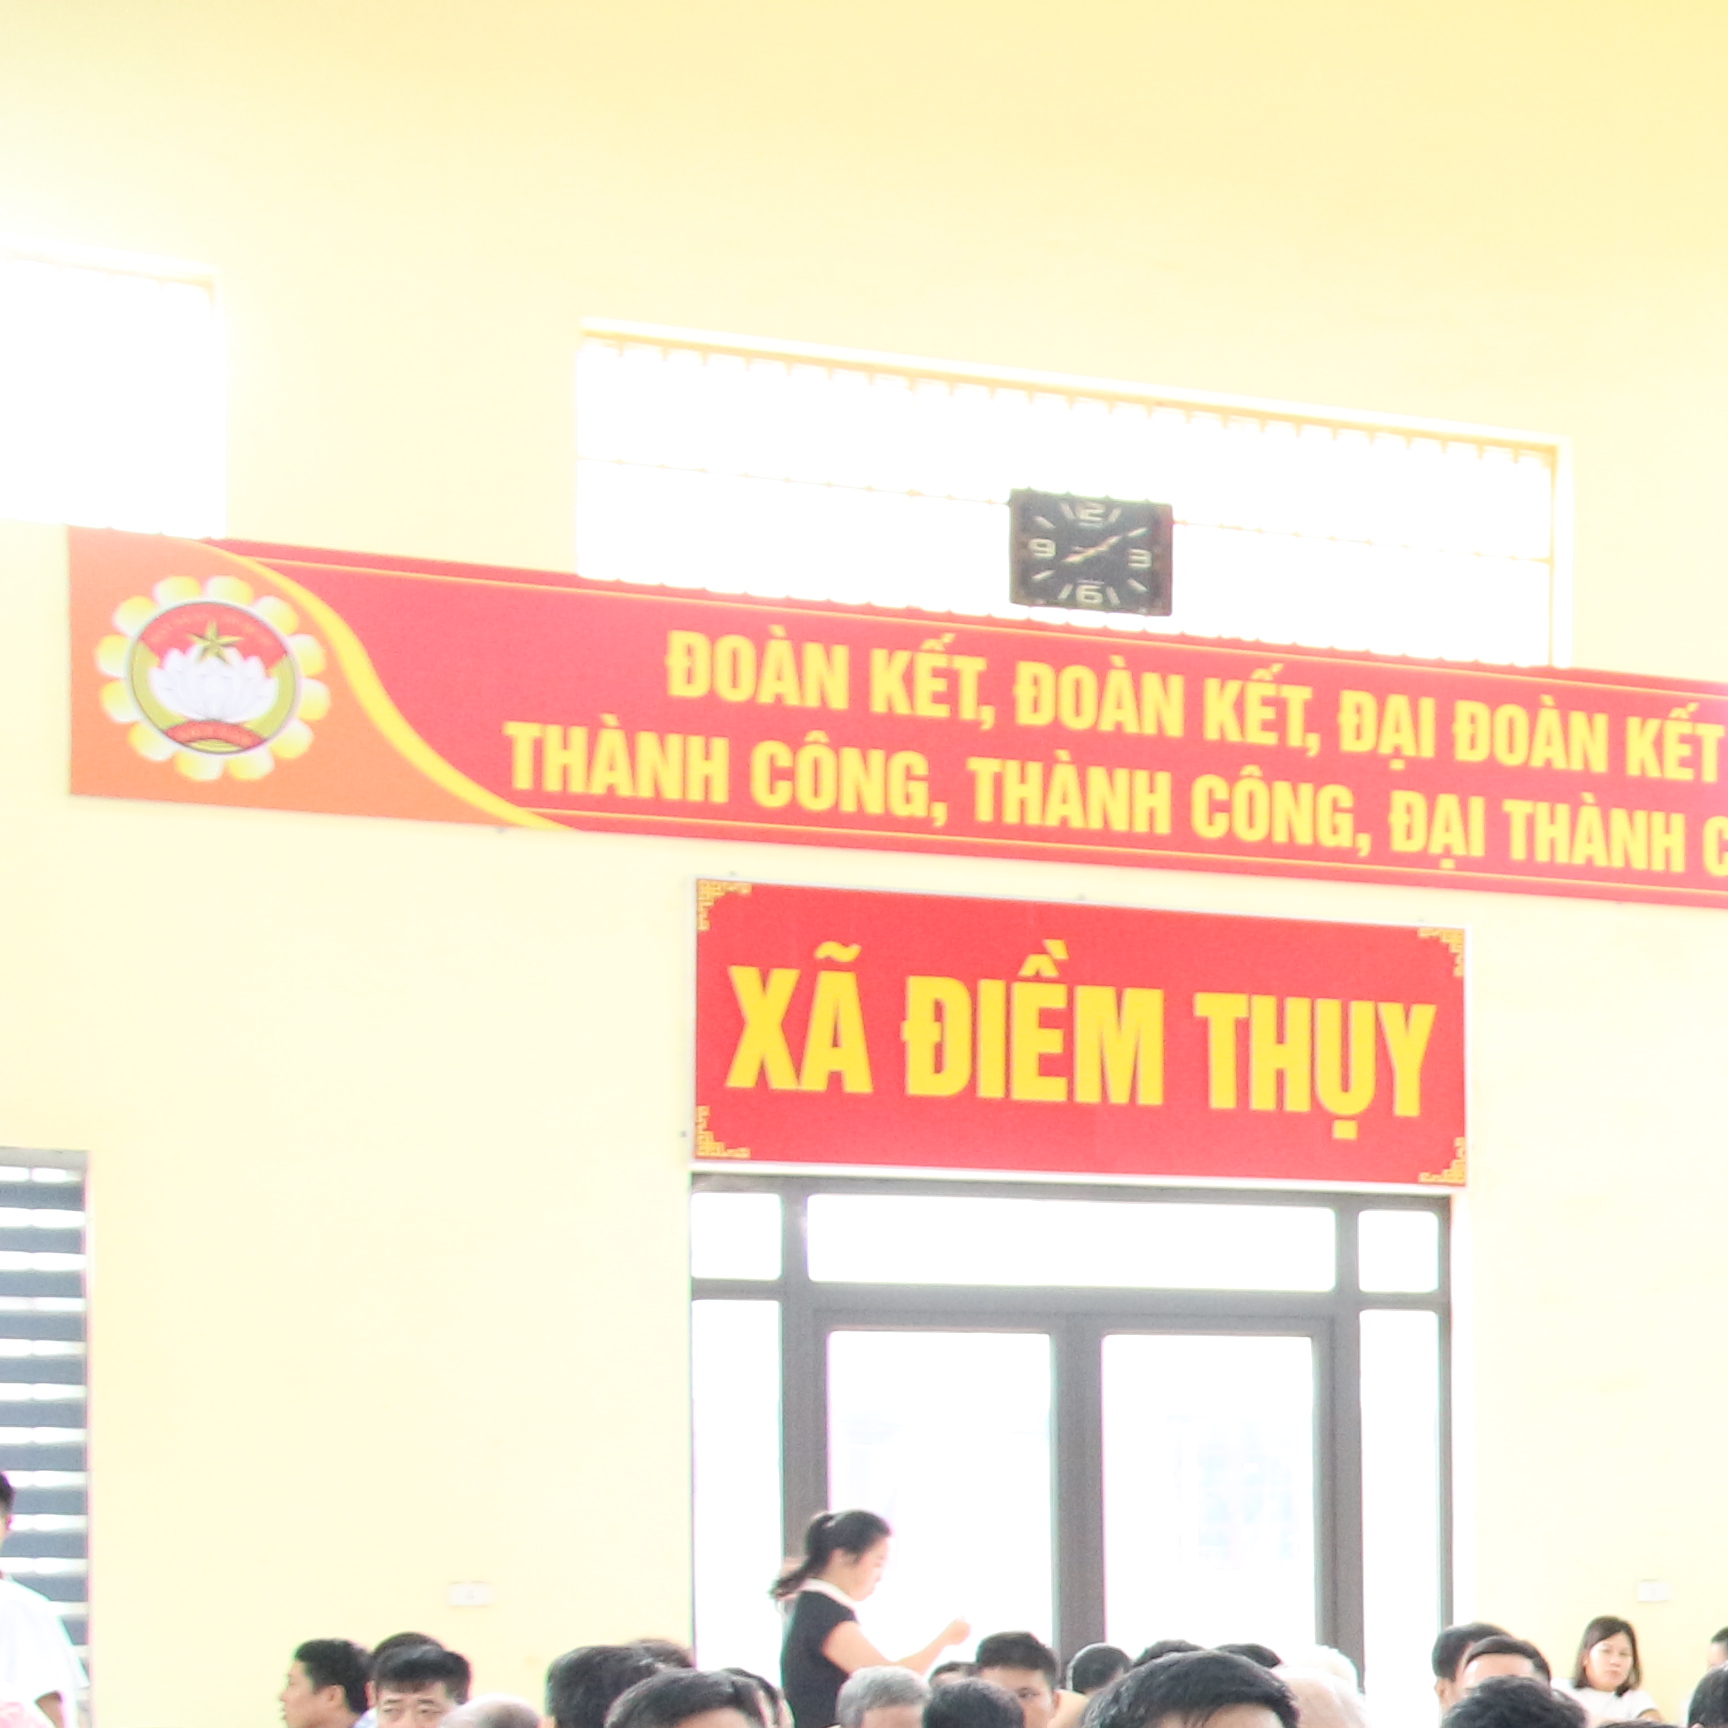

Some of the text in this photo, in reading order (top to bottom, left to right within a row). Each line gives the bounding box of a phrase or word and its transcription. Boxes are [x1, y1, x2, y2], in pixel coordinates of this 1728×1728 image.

[1028, 538, 1056, 559] 9
[1127, 549, 1153, 569] 3
[1076, 585, 1103, 604] 6
[665, 624, 1726, 783] ĐOÀN KẾT, ĐOÀN KẾT, ĐẠI ĐOÀN KẾT
[504, 713, 730, 804] THÀNH
[749, 729, 949, 828] CÔNG,
[966, 749, 1173, 834] THÀNH
[1191, 764, 1373, 857] CÔNG,
[1388, 789, 1486, 870] ĐẠI
[1503, 792, 1687, 873] THÀNH
[725, 939, 1438, 1140] XÃ ĐIỀM THỤY
